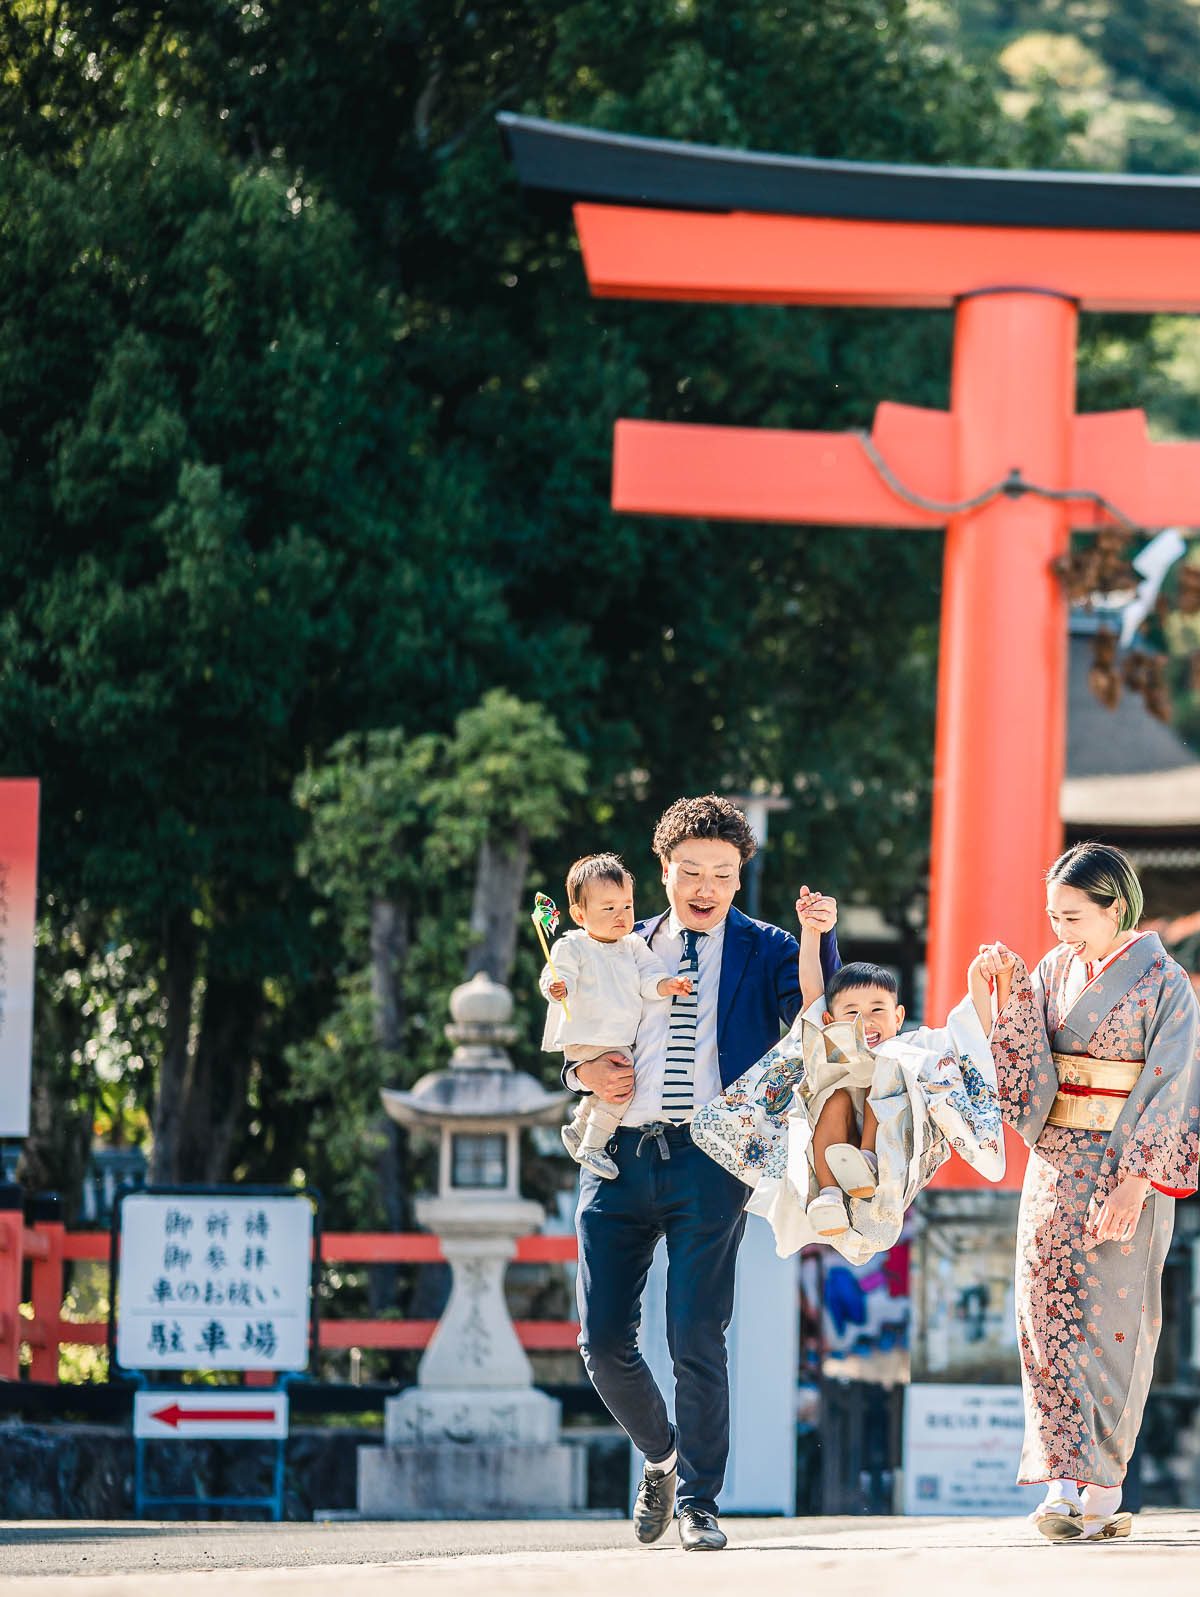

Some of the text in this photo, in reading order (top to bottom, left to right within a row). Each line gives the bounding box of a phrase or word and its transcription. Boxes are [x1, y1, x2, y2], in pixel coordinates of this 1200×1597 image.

[164, 1242, 270, 1272] 御参拝
[147, 1319, 278, 1358] 駐車場
